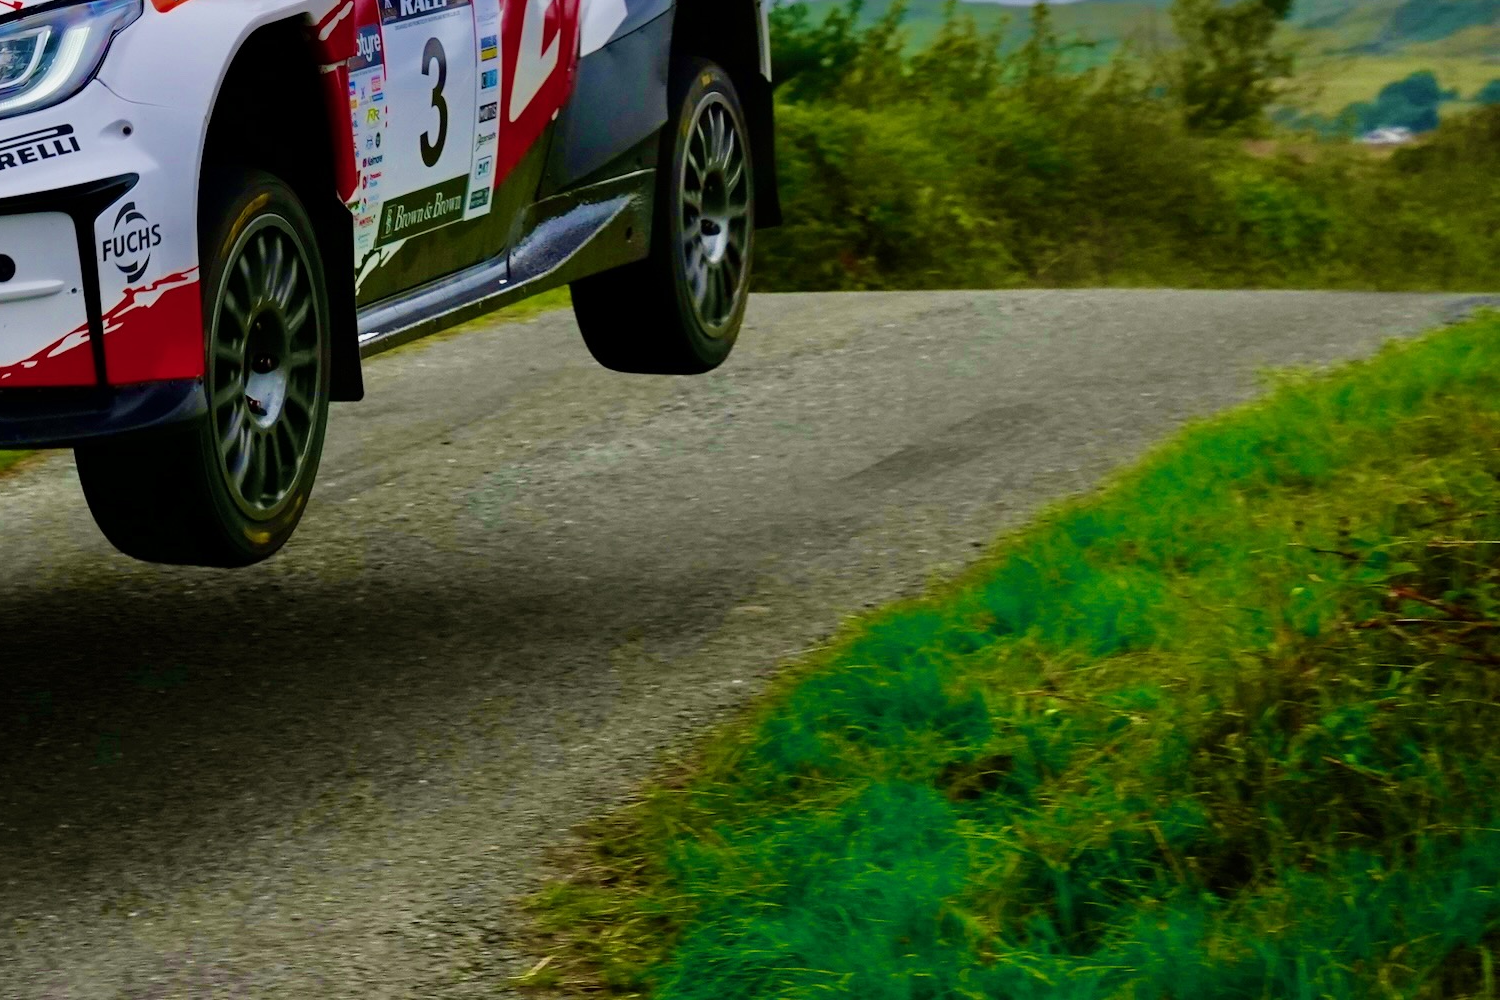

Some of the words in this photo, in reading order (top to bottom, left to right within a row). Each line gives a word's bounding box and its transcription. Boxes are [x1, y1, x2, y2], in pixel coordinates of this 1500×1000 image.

[419, 37, 448, 168] 3
[394, 205, 424, 231] Brown
[432, 192, 462, 219] Brown
[102, 223, 162, 262] FUCHS
